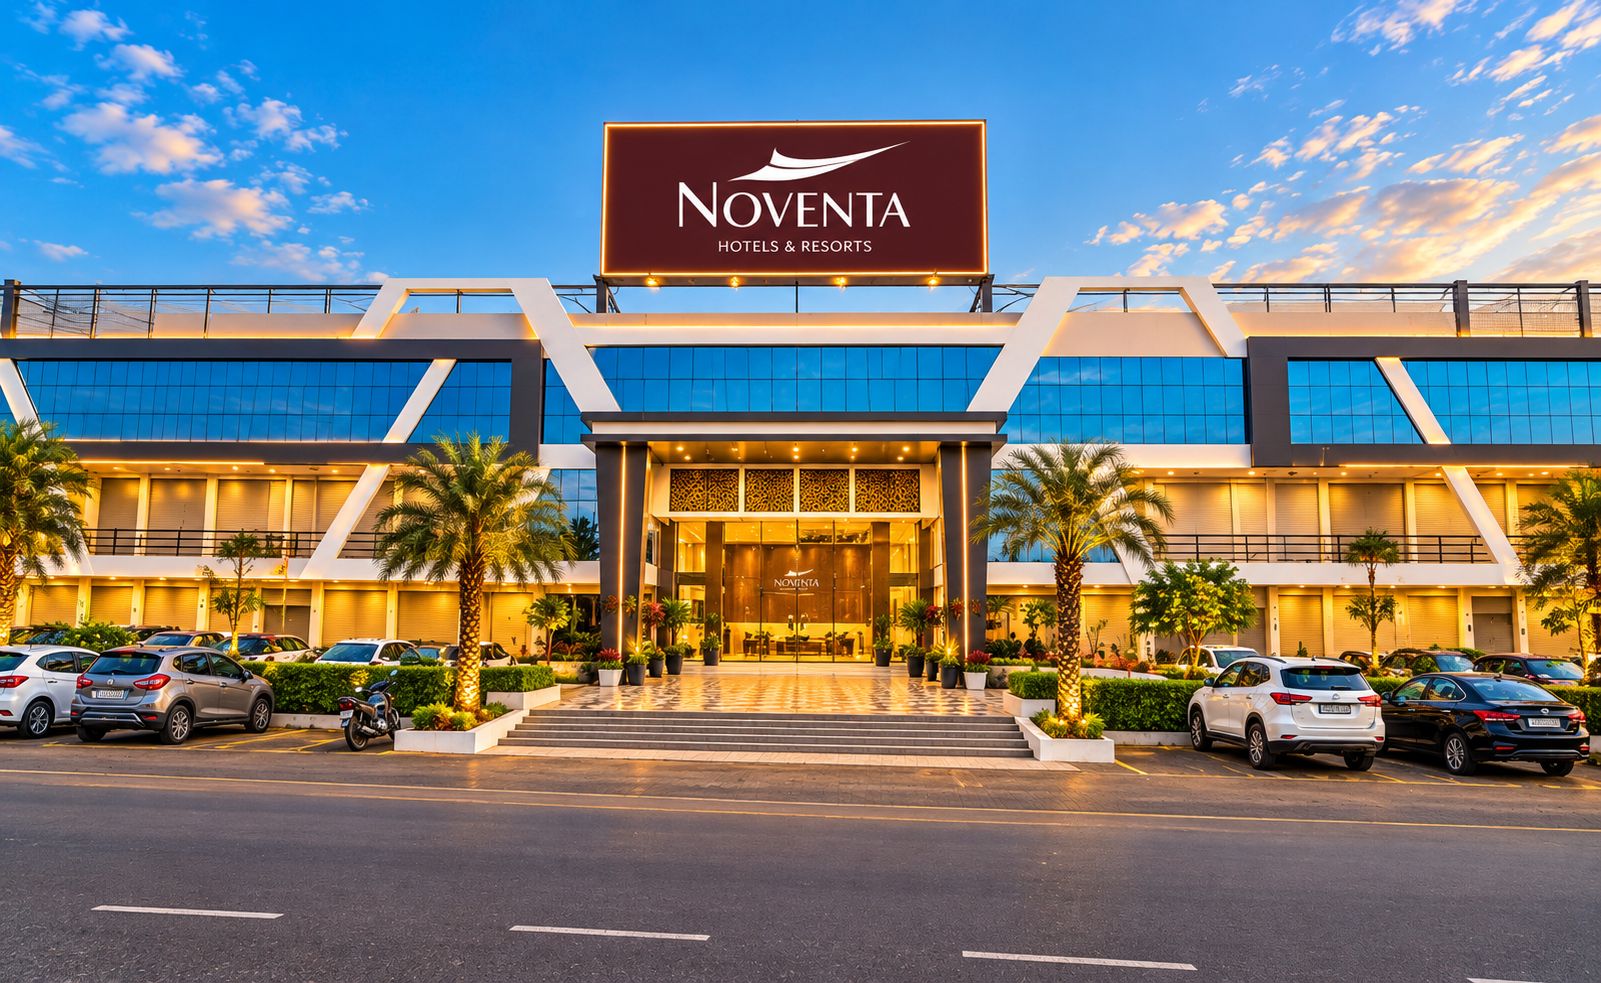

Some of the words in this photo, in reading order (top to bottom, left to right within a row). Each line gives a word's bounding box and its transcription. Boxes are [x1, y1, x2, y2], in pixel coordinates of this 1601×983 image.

[678, 181, 911, 228] NOVENTA
[718, 240, 779, 253] HOTELS
[784, 240, 796, 253] &
[801, 240, 872, 253] RESORTS
